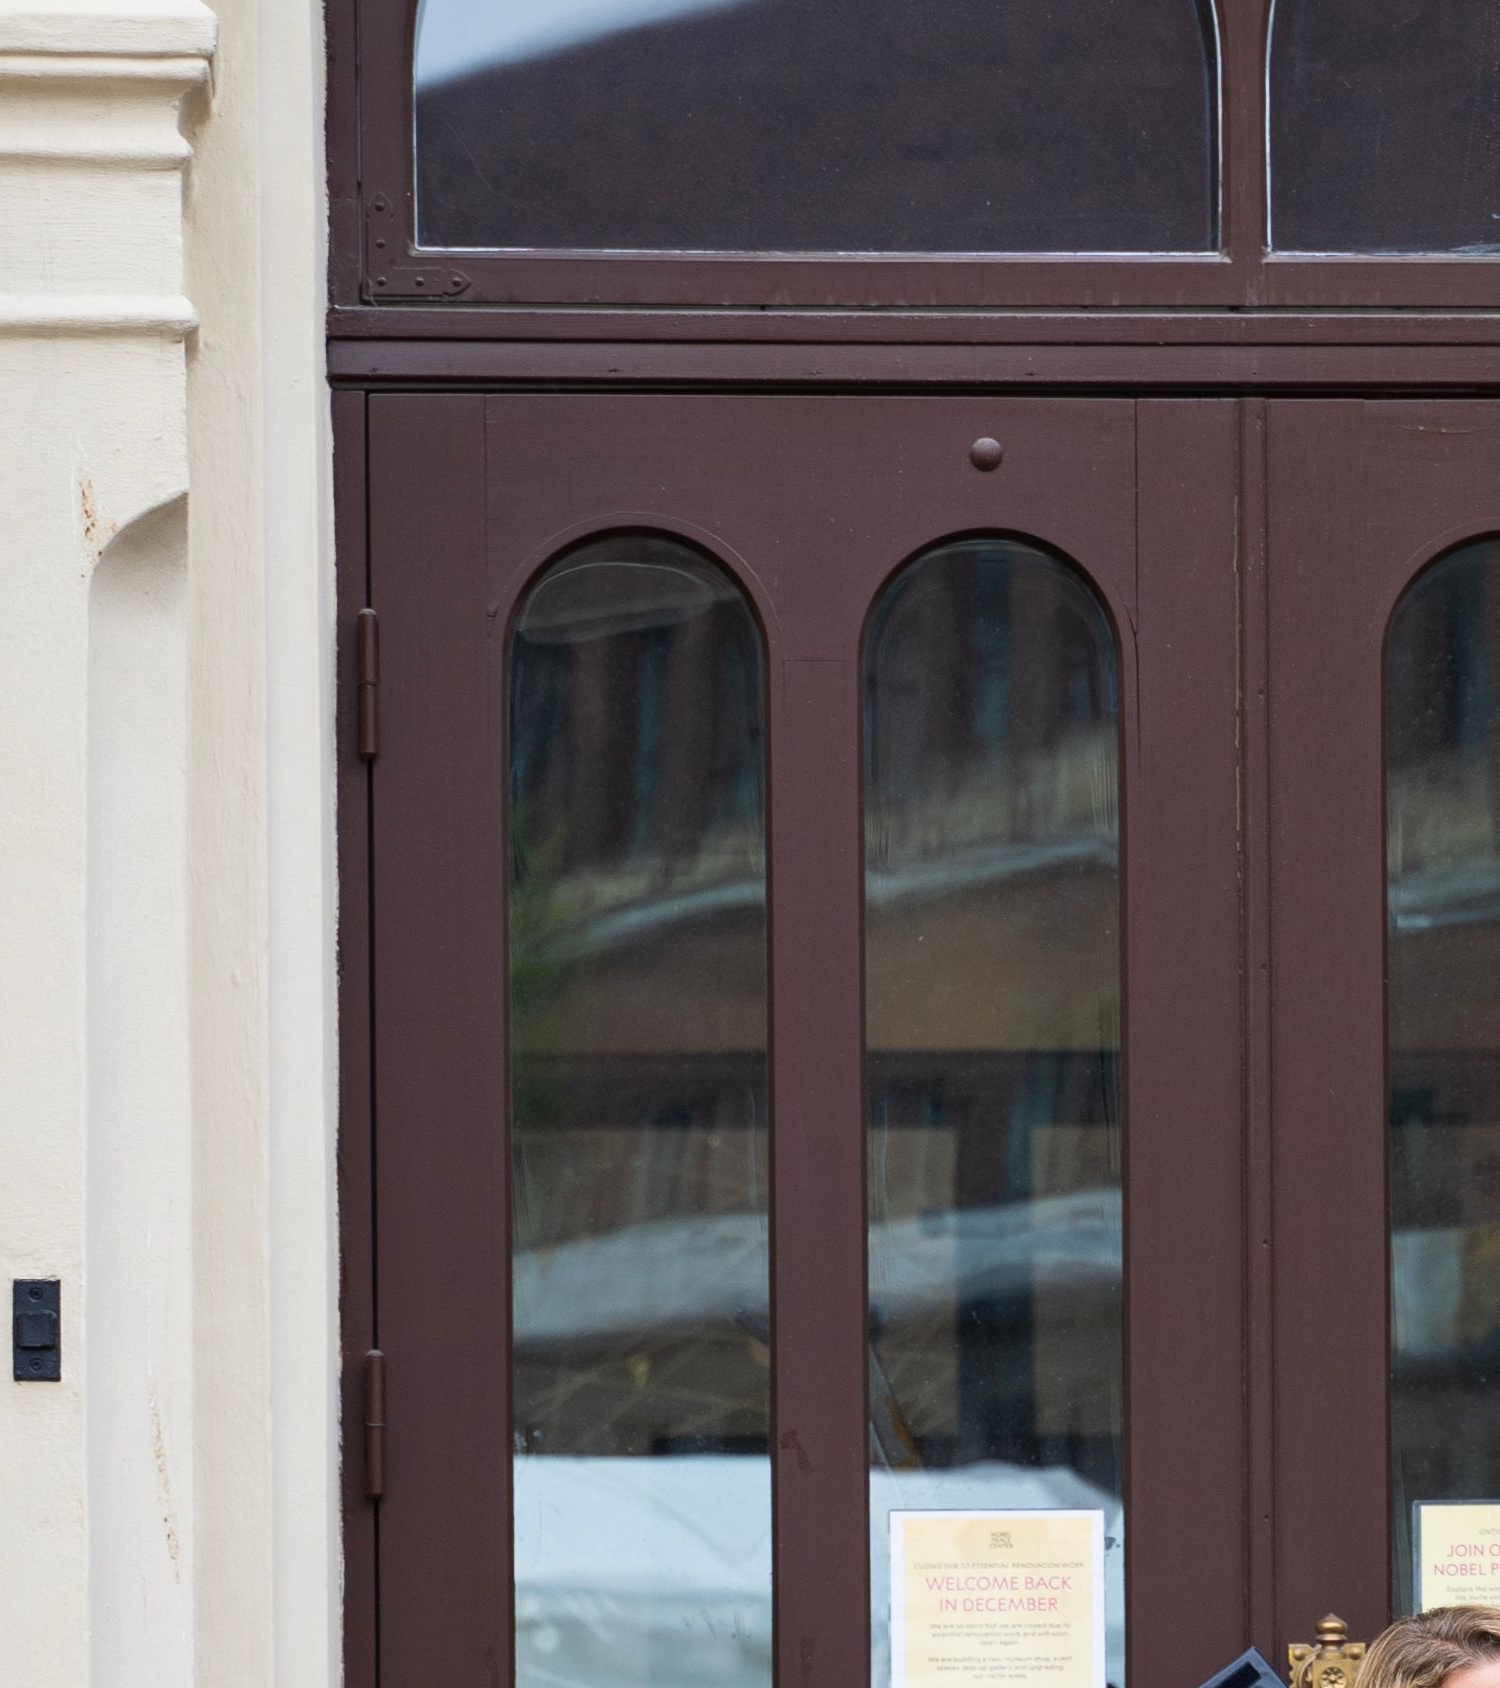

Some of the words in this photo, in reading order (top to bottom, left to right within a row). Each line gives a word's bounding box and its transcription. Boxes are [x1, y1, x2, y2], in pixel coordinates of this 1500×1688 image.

[1446, 1544, 1484, 1557] JOIN
[1434, 1564, 1486, 1576] NOBEL
[926, 1576, 1019, 1592] WELCOME
[1024, 1576, 1072, 1590] BACK
[940, 1598, 957, 1612] IN
[963, 1597, 1059, 1612] DECEMBER
